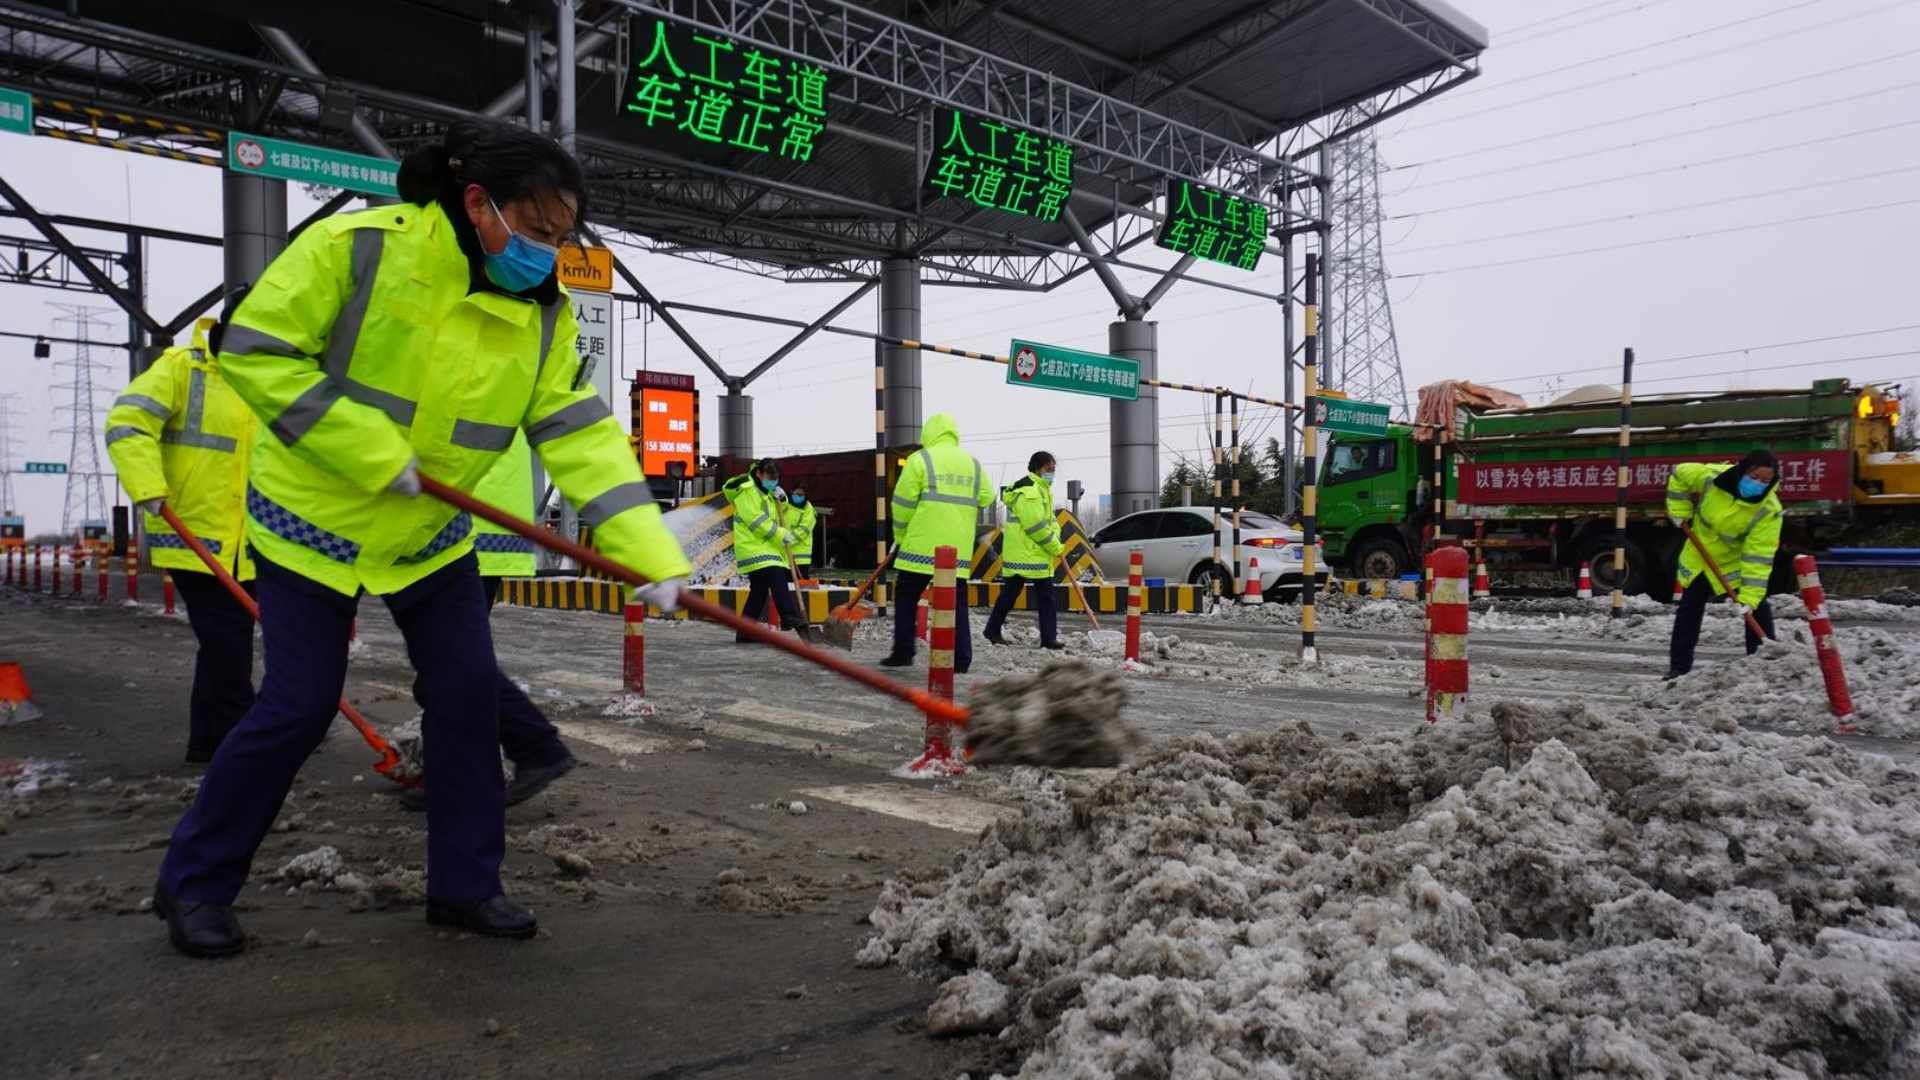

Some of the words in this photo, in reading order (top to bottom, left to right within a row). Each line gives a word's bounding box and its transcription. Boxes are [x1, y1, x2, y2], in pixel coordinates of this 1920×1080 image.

[639, 21, 828, 116] 人工车道
[627, 74, 824, 161] 车道正常
[942, 111, 1073, 185] 人工车道
[930, 154, 1070, 222] 车道正常
[1175, 181, 1268, 240] 人工车道
[563, 263, 602, 280] km/h
[1164, 218, 1265, 271] 车道正常
[1476, 462, 1680, 489] 以雪为令快速反应全做好
